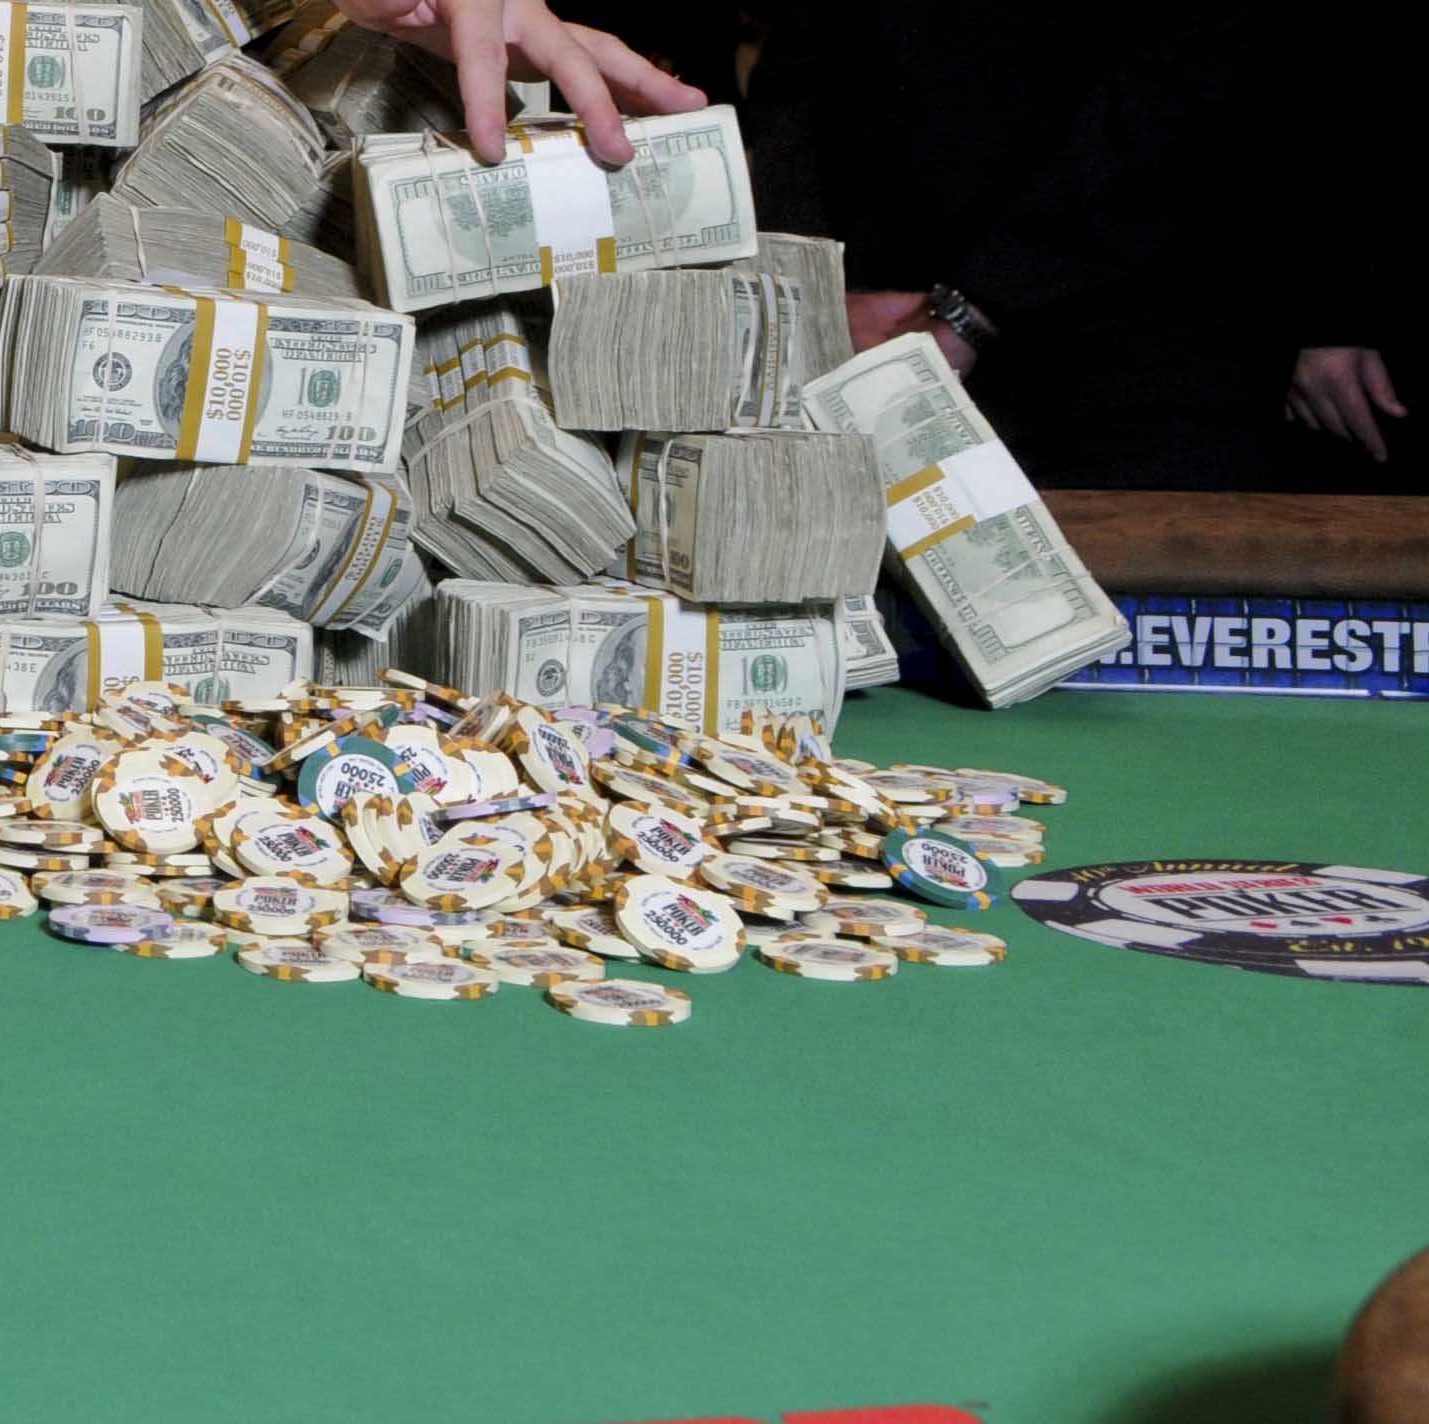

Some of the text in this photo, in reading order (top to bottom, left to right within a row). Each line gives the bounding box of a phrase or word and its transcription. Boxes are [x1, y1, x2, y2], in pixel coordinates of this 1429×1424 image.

[206, 348, 233, 420] $10,000
[226, 349, 251, 422] $10,000
[1143, 888, 1411, 920] POKER
